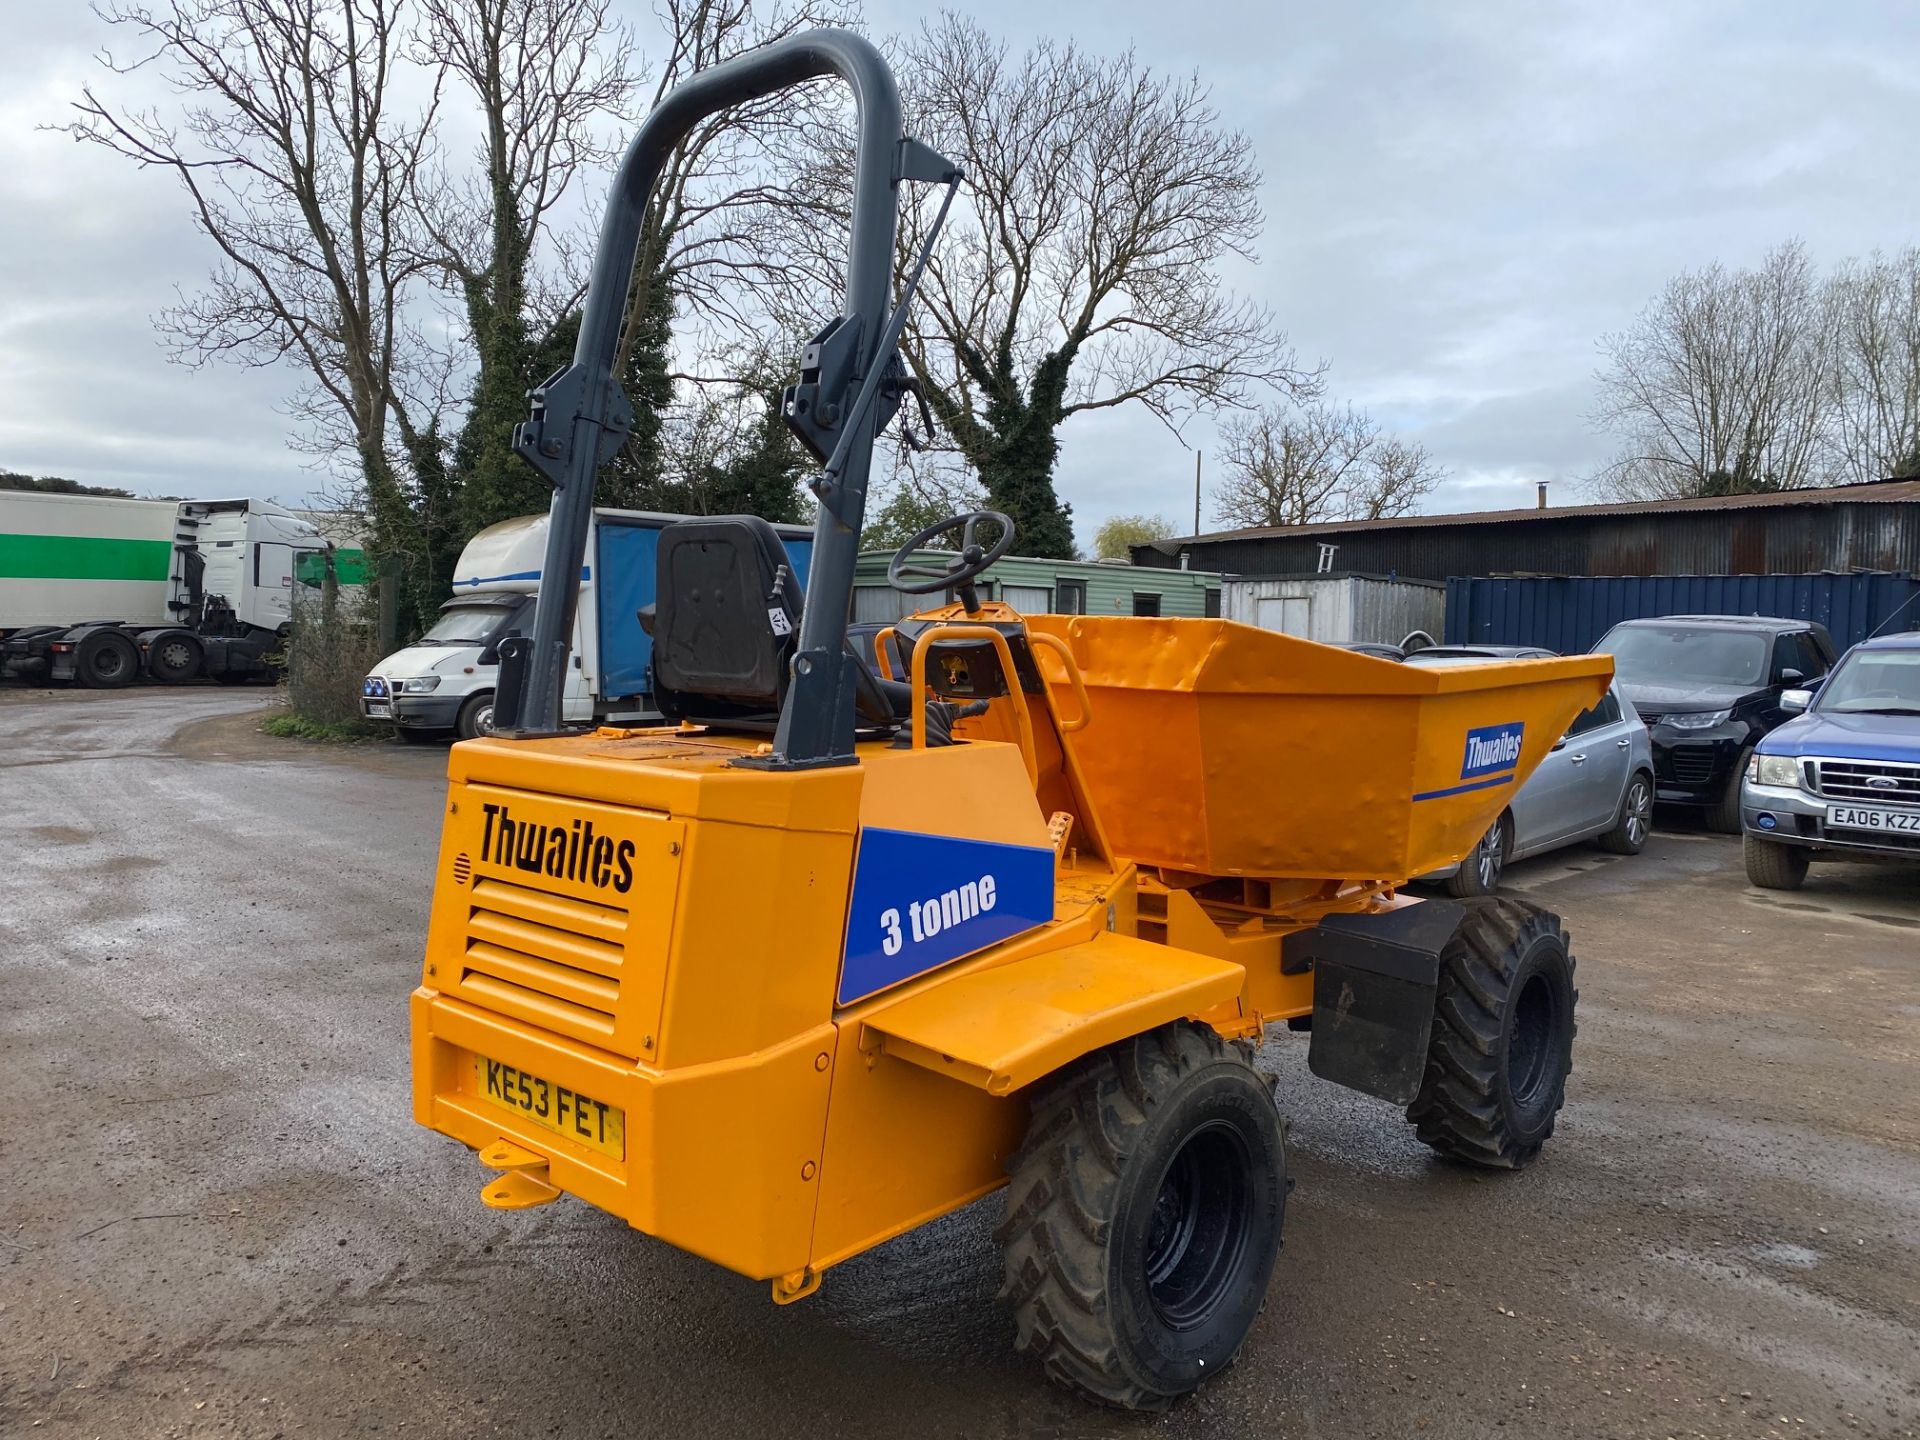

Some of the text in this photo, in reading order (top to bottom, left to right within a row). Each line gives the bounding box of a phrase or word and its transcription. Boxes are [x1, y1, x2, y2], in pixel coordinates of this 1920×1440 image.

[1467, 731, 1522, 769] Thwaites
[481, 803, 636, 894] Thwaites
[1834, 808, 1920, 830] EA06 KZZ
[880, 874, 996, 956] 3 tonne
[487, 1057, 609, 1143] KE53 FET
